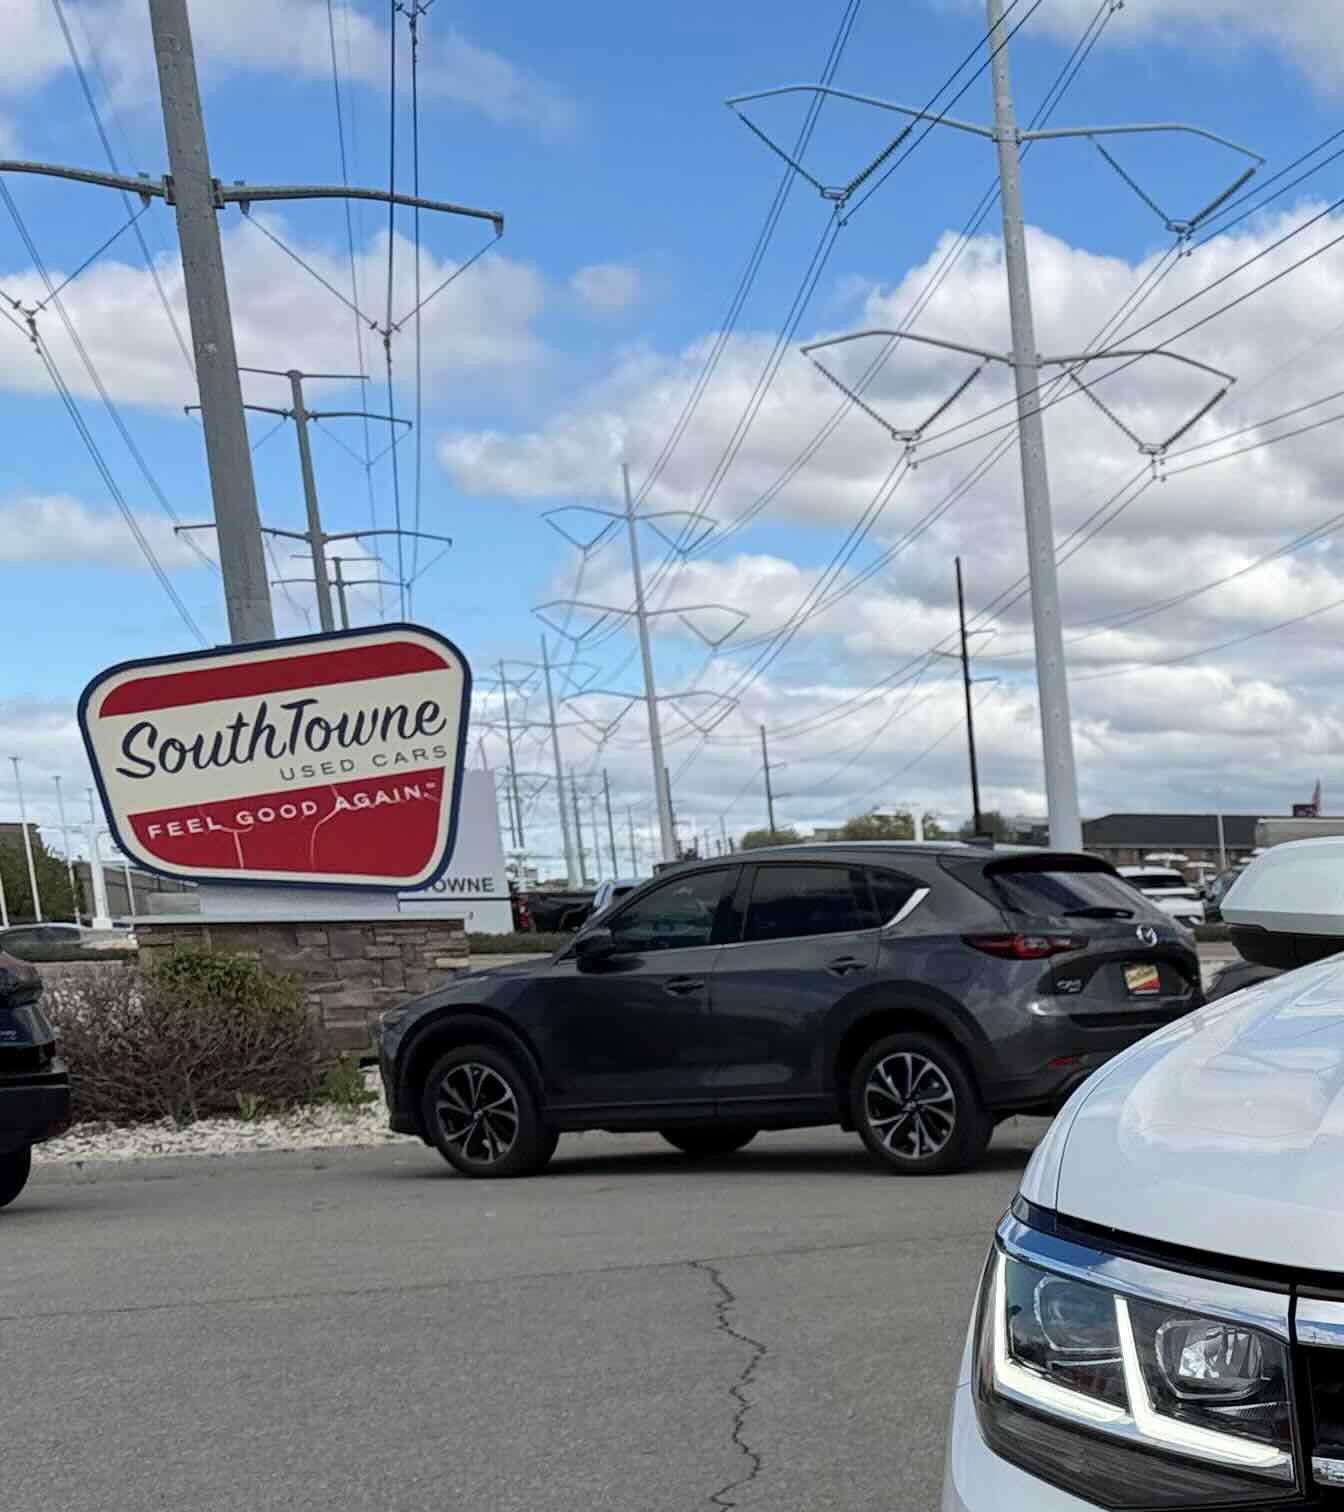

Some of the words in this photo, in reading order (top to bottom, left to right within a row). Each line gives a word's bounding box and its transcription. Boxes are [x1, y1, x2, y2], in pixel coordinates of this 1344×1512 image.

[116, 698, 447, 779] SouthTowne
[280, 758, 355, 781] USED
[371, 745, 447, 768] CARS
[147, 818, 223, 840] FEEL
[236, 800, 318, 826] GOOD
[426, 877, 495, 893] OWNE
